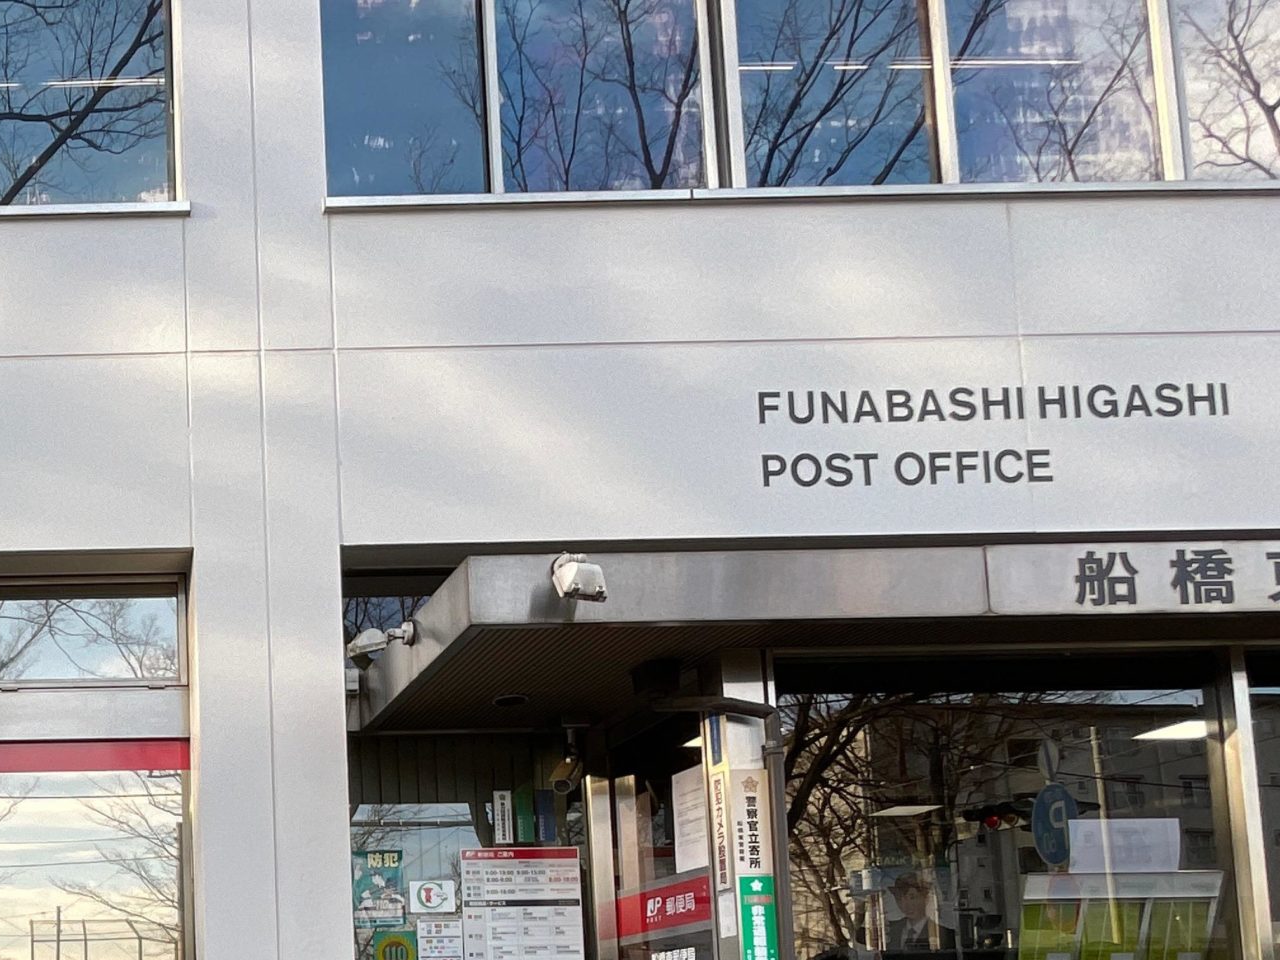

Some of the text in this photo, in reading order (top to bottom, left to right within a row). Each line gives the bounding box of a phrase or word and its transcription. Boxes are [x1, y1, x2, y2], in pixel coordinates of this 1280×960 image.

[757, 383, 1230, 424] FUNABASHI HIGASHI
[761, 449, 1054, 487] POST OFFICE
[1075, 549, 1280, 606] 船橋
[745, 796, 761, 869] 警察官立寄所
[367, 852, 399, 868] 防犯
[666, 892, 695, 916] 郵便局
